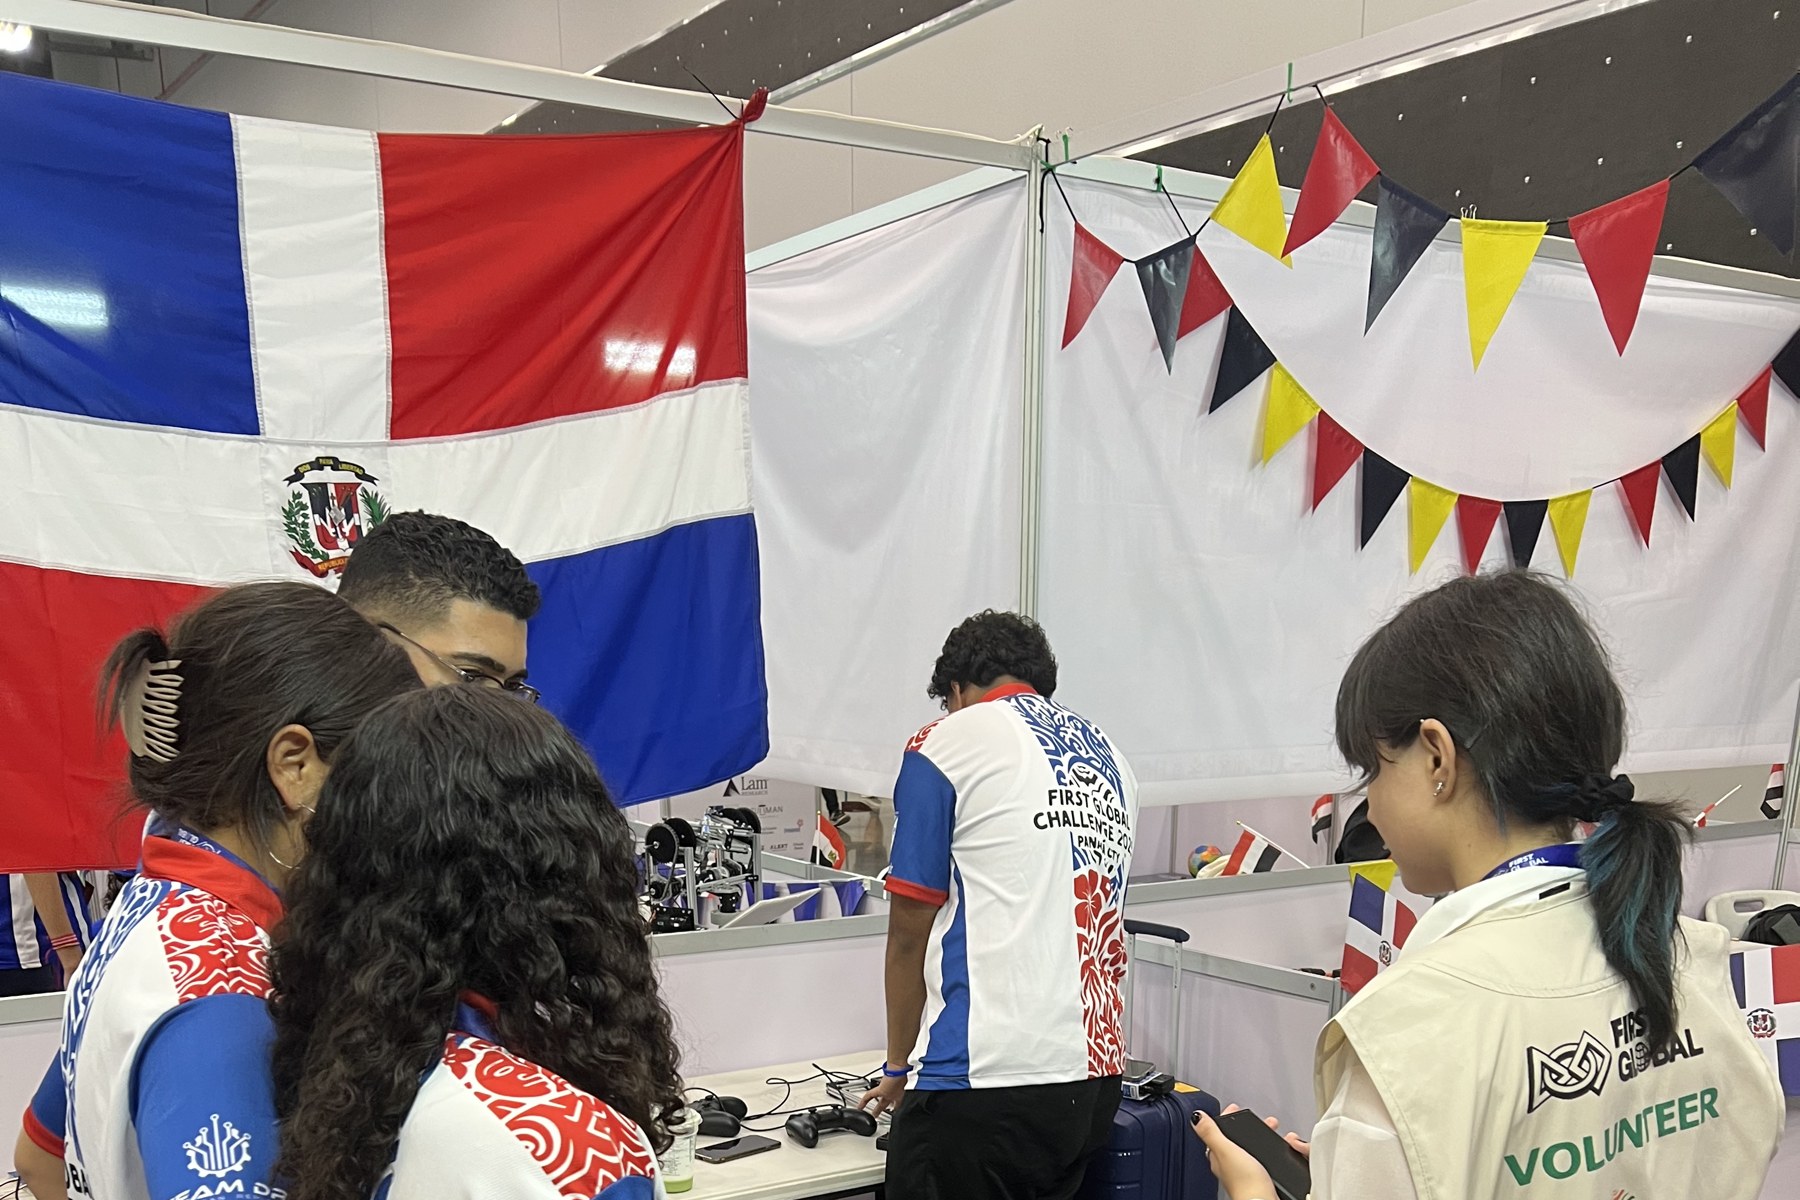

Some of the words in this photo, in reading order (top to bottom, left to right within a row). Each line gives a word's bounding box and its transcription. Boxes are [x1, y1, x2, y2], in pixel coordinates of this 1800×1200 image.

[741, 776, 768, 791] Lam
[1048, 789, 1090, 808] FIRST
[1092, 797, 1131, 832] GLOBAL
[1508, 853, 1534, 868] FIRST
[1504, 1087, 1719, 1186] VOLUNTEER
